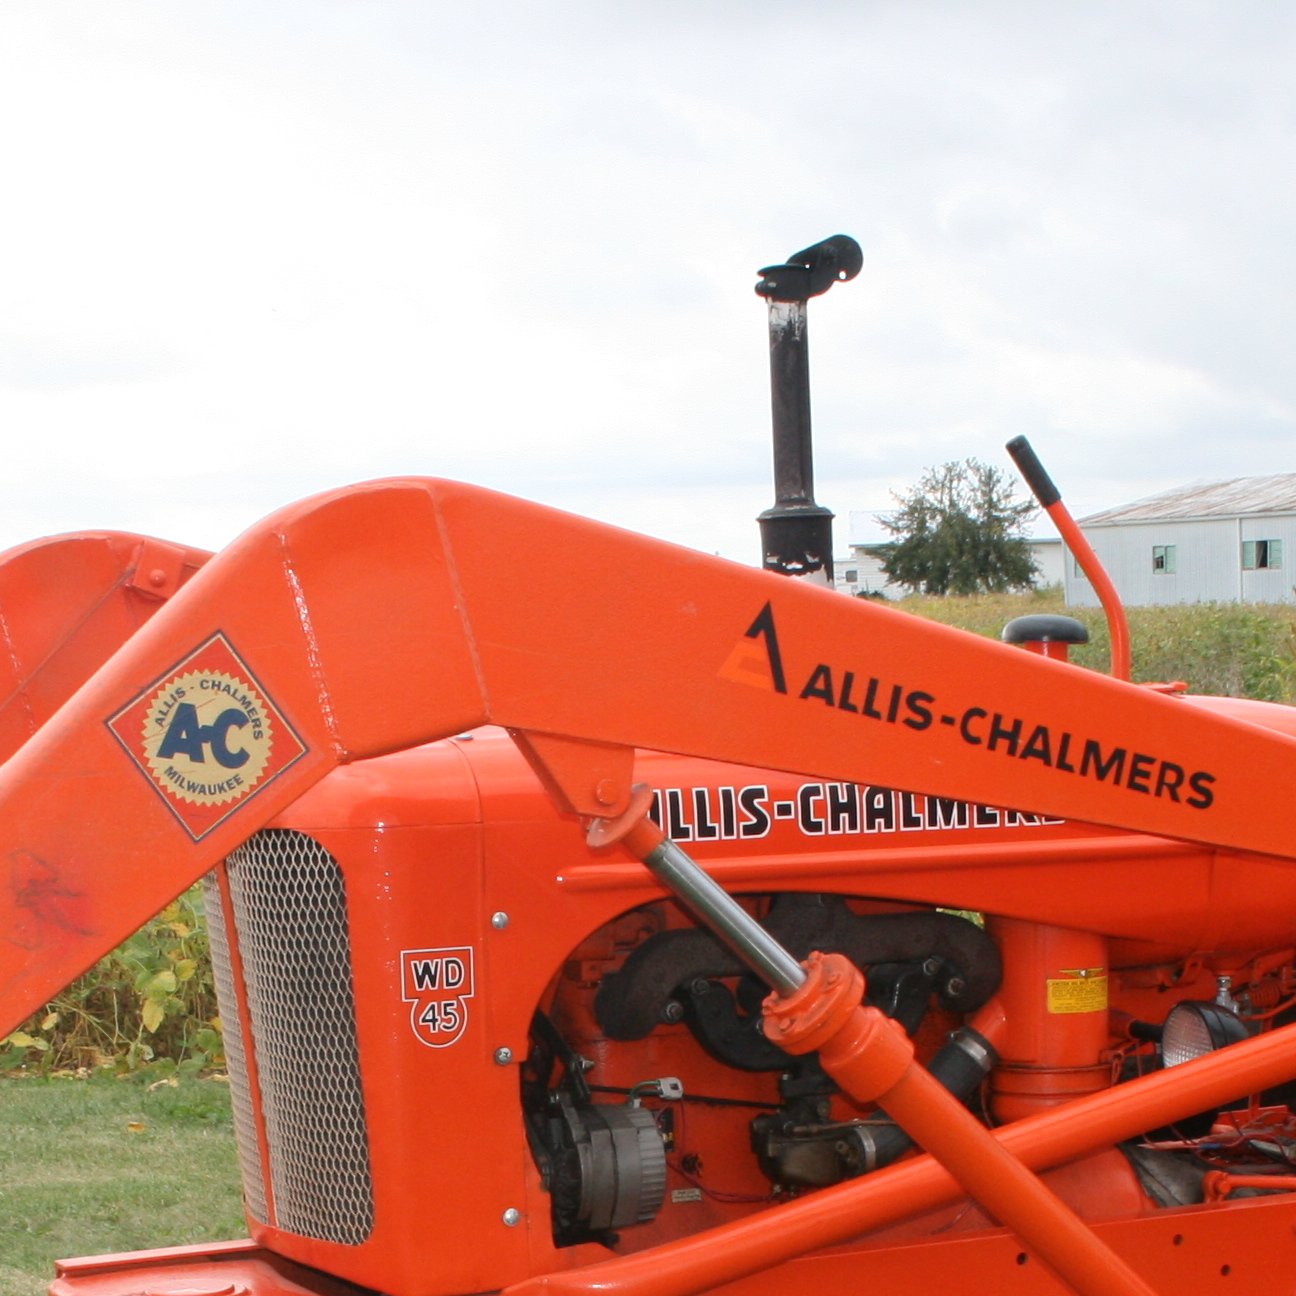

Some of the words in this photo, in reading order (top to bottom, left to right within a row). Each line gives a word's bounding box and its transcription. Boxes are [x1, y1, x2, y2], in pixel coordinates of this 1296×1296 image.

[799, 664, 1217, 810] ALLIS-CHALMERS
[164, 766, 245, 796] MILWAUKEE
[648, 783, 1066, 842] LLIS-CHALM
[411, 957, 465, 991] WD
[419, 1000, 460, 1033] 45
